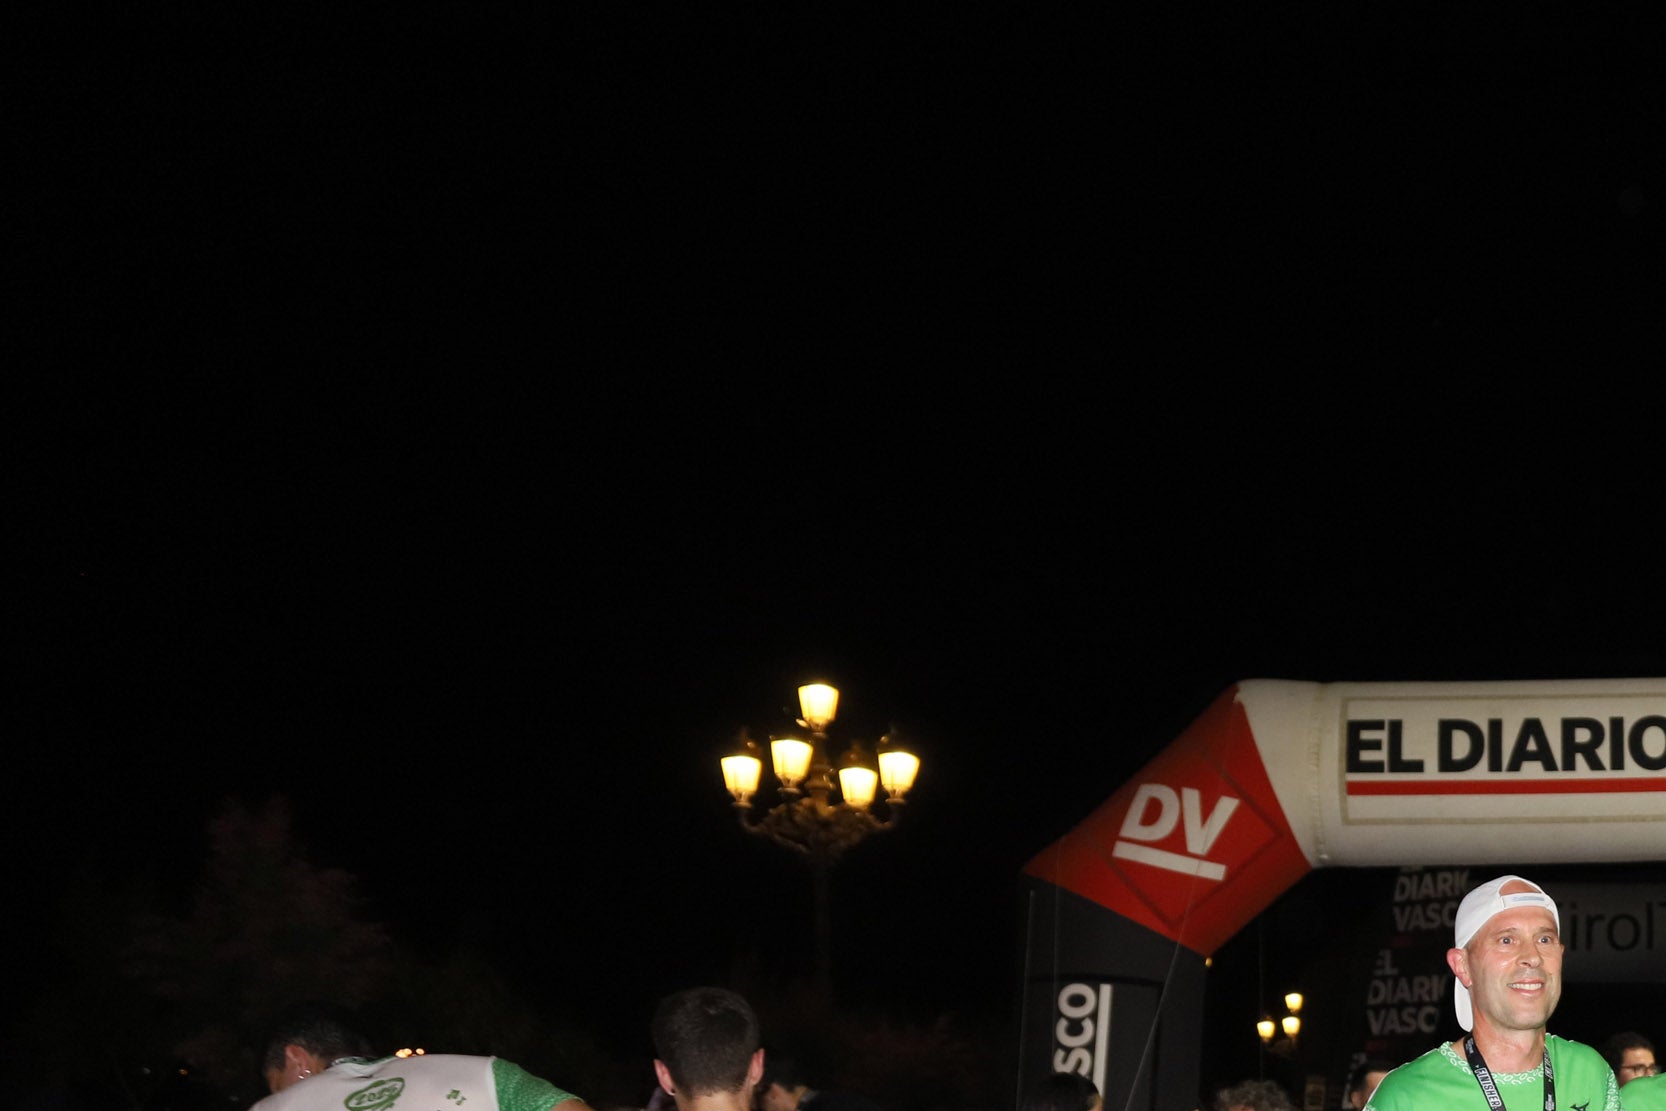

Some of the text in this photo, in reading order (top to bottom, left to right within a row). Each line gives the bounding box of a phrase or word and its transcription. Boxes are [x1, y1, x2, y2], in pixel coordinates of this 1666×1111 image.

[1345, 717, 1425, 774] EL
[1117, 782, 1241, 856] DV
[473, 868, 521, 886] HOKA
[1475, 1067, 1502, 1109] FINISHER
